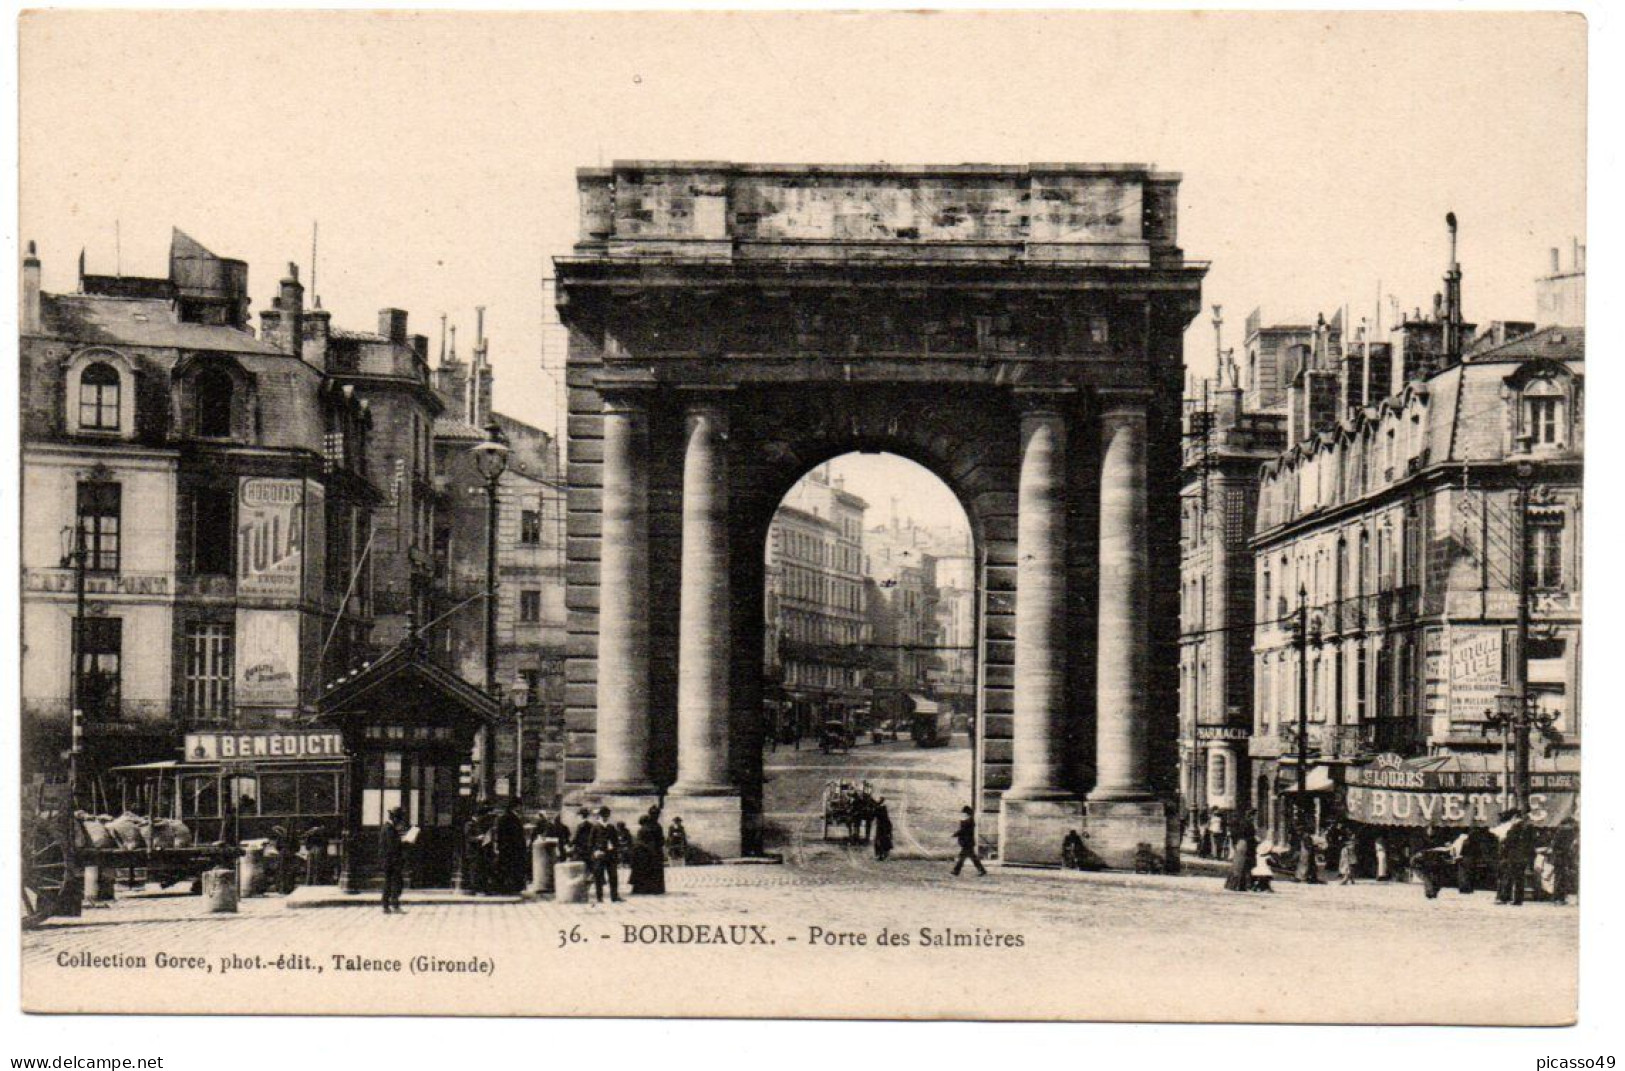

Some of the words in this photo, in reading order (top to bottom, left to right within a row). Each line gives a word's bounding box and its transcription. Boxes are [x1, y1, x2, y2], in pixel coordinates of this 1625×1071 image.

[239, 503, 302, 581] TULA
[1376, 752, 1403, 771] BAR
[1437, 772, 1456, 787] VIN
[1460, 772, 1491, 787] ROUGE
